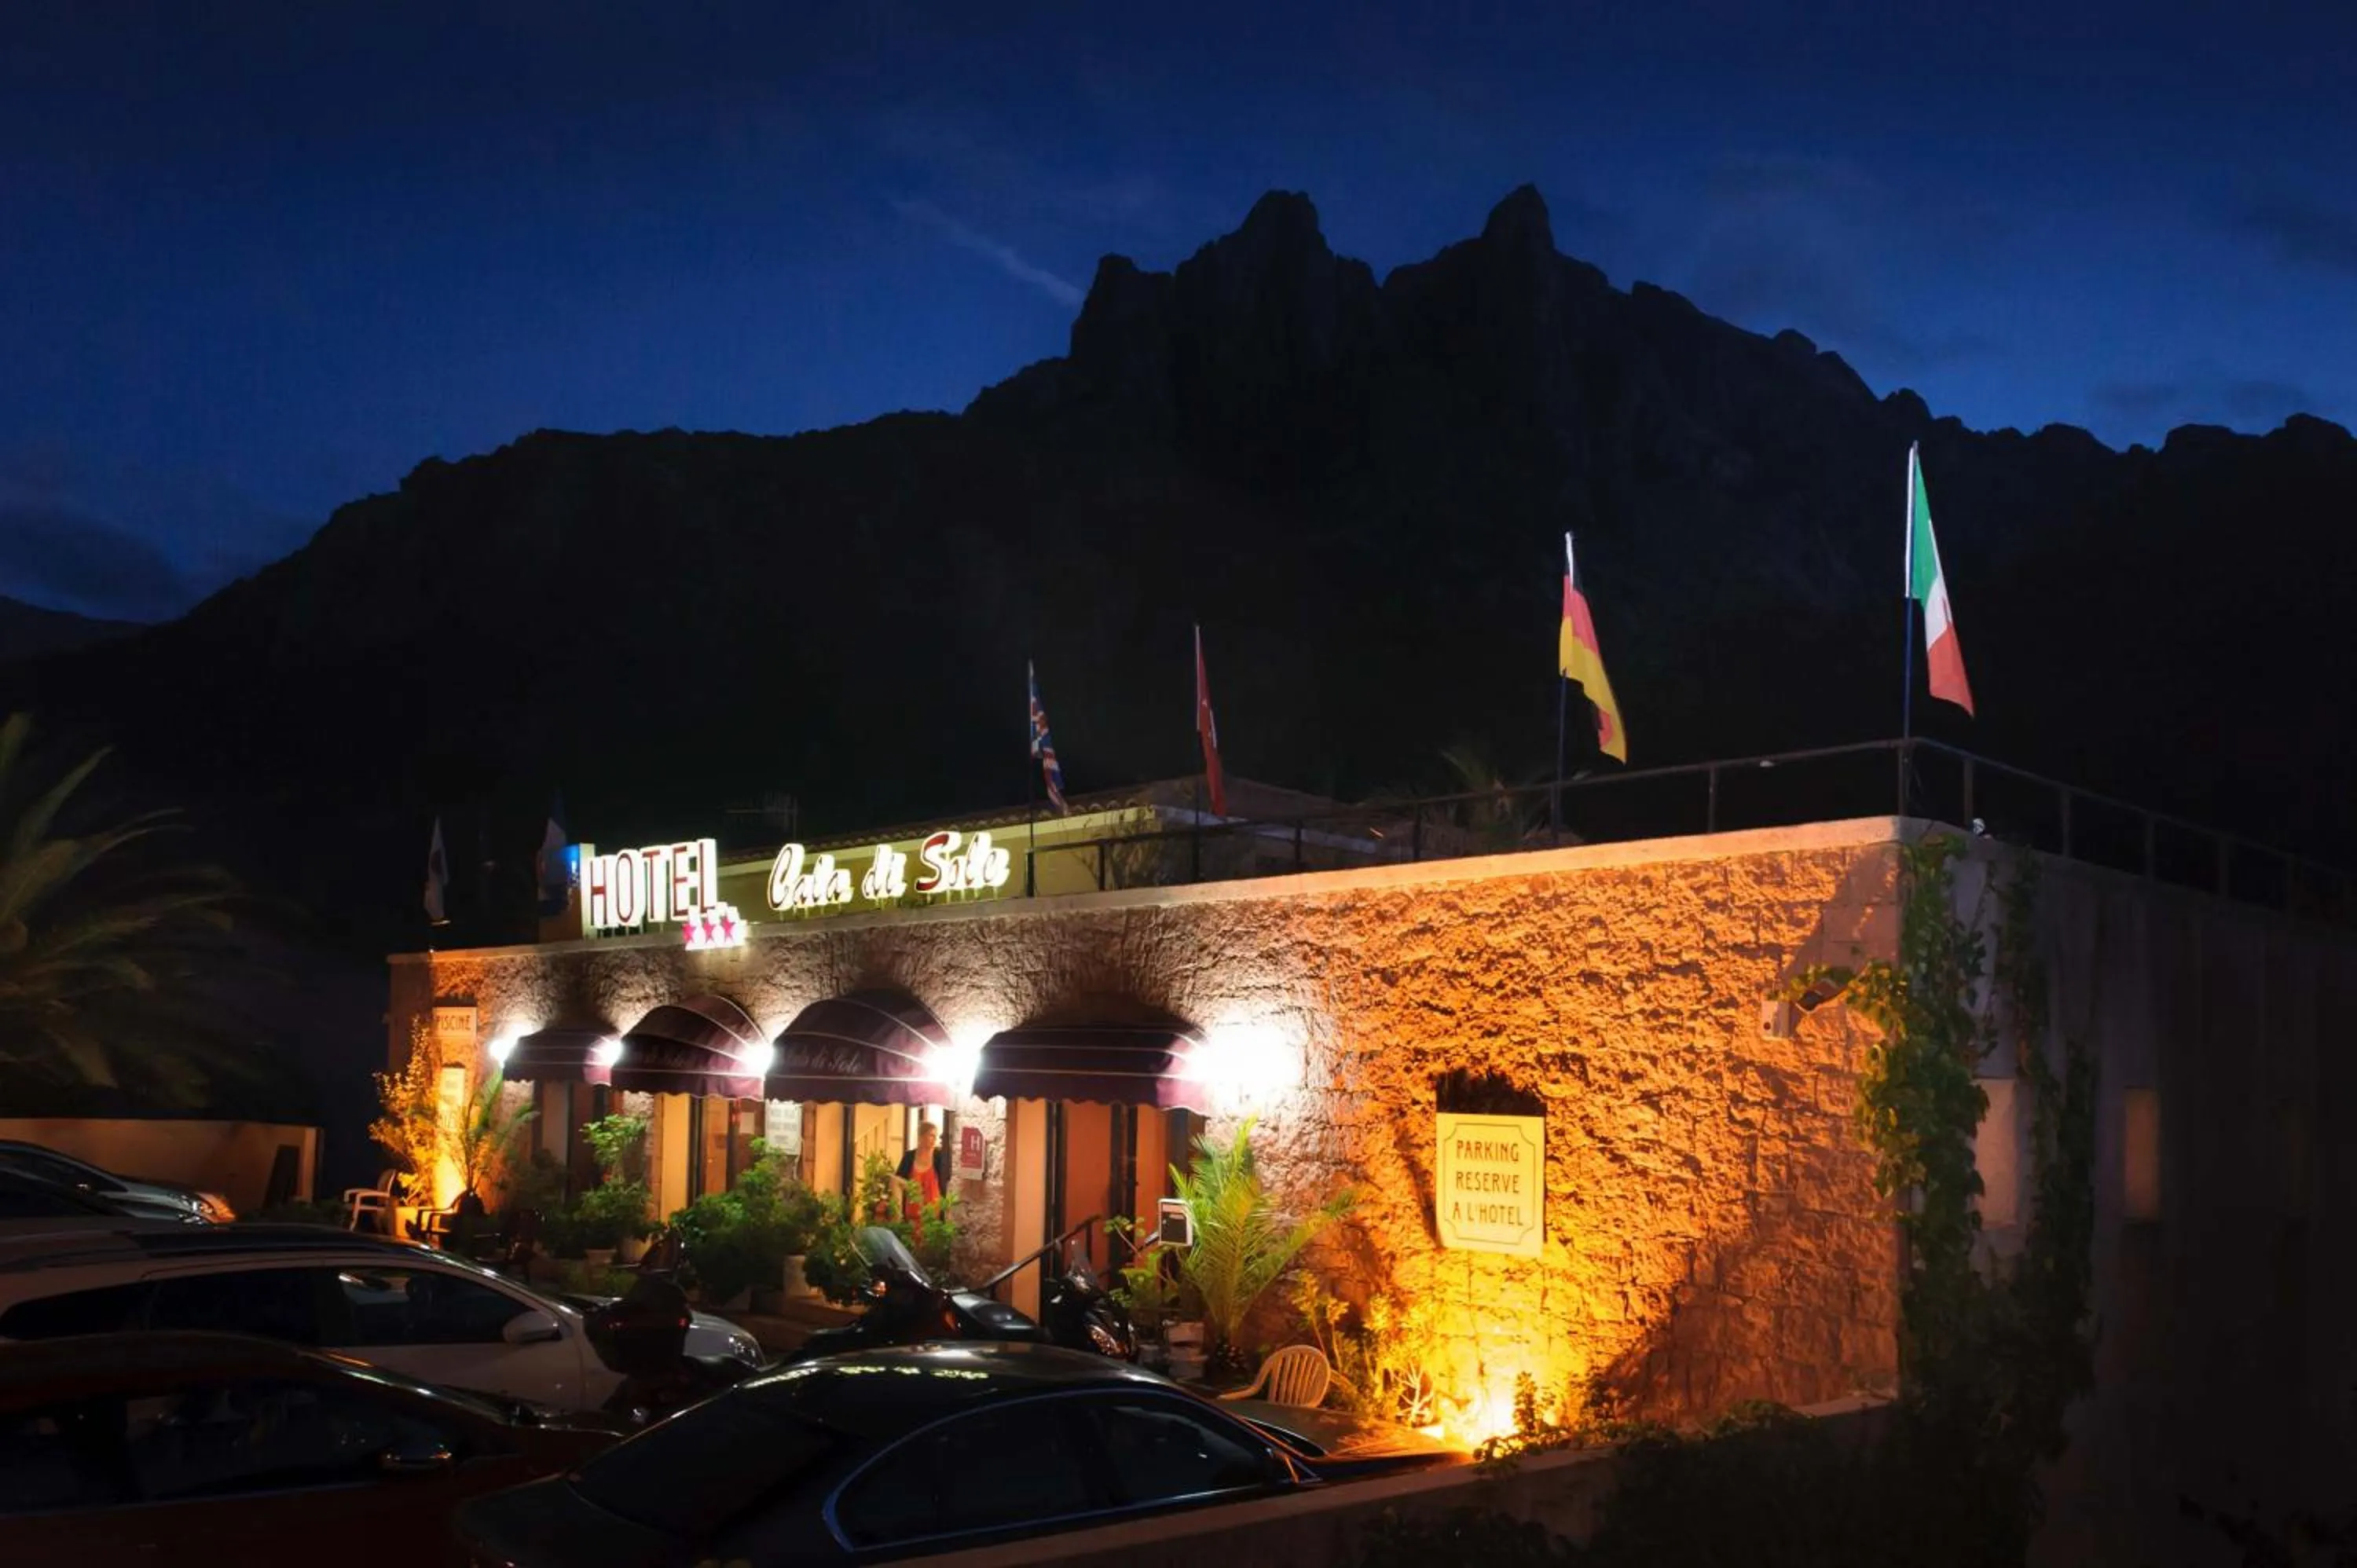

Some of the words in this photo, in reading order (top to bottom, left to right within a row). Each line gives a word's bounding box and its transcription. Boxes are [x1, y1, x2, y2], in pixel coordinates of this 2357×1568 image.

[863, 844, 907, 898] di
[915, 831, 1010, 892] Sole
[583, 839, 717, 928] HOTEL
[970, 1135, 981, 1151] H
[1457, 1140, 1519, 1162] PARKING
[1467, 1202, 1523, 1226] L'HOTEL
